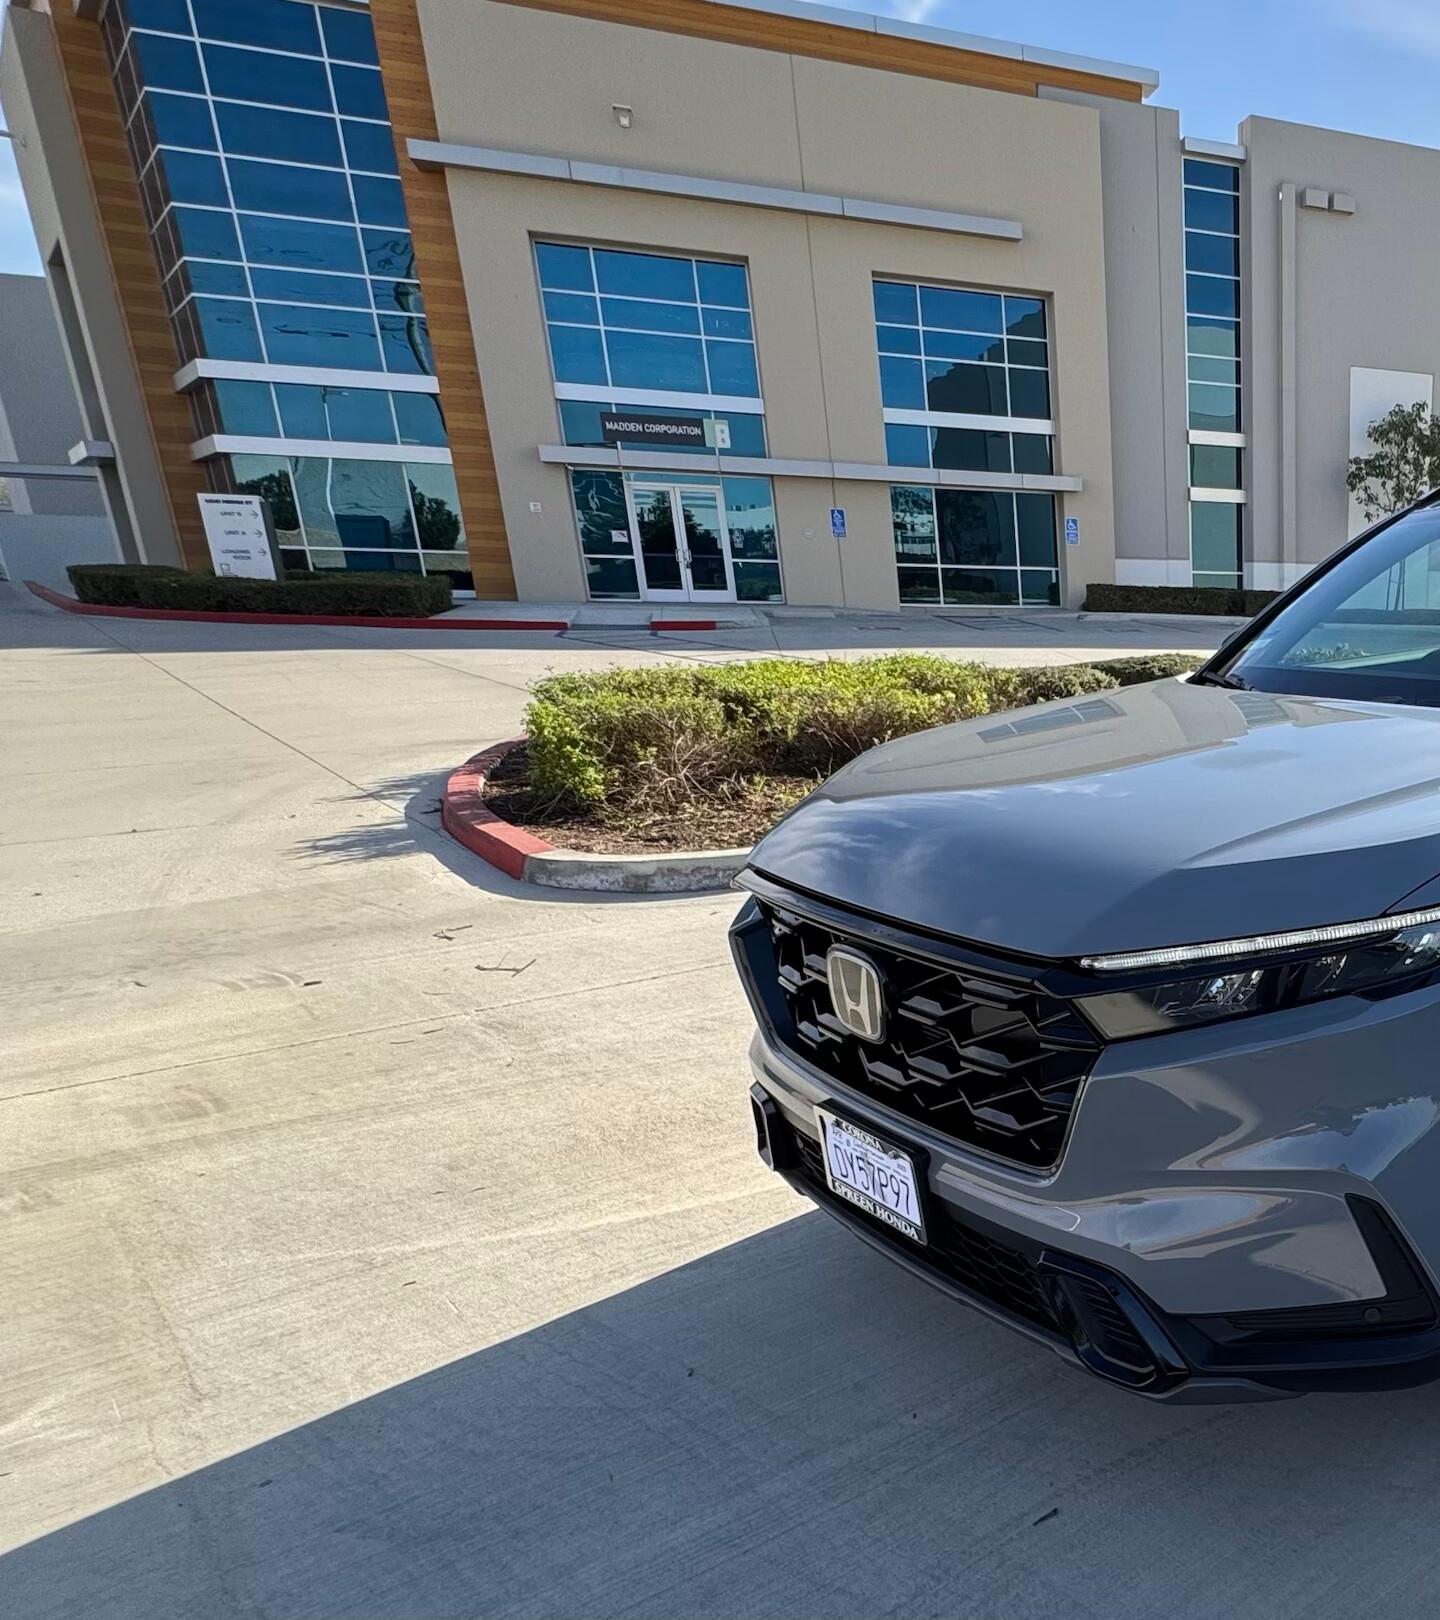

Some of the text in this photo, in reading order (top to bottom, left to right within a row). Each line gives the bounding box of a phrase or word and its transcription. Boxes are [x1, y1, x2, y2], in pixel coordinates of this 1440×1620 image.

[605, 421, 701, 435] MADDEN CORPORATION
[834, 1144, 910, 1216] DY57P97
[835, 1182, 919, 1240] SPREEN HONDA
